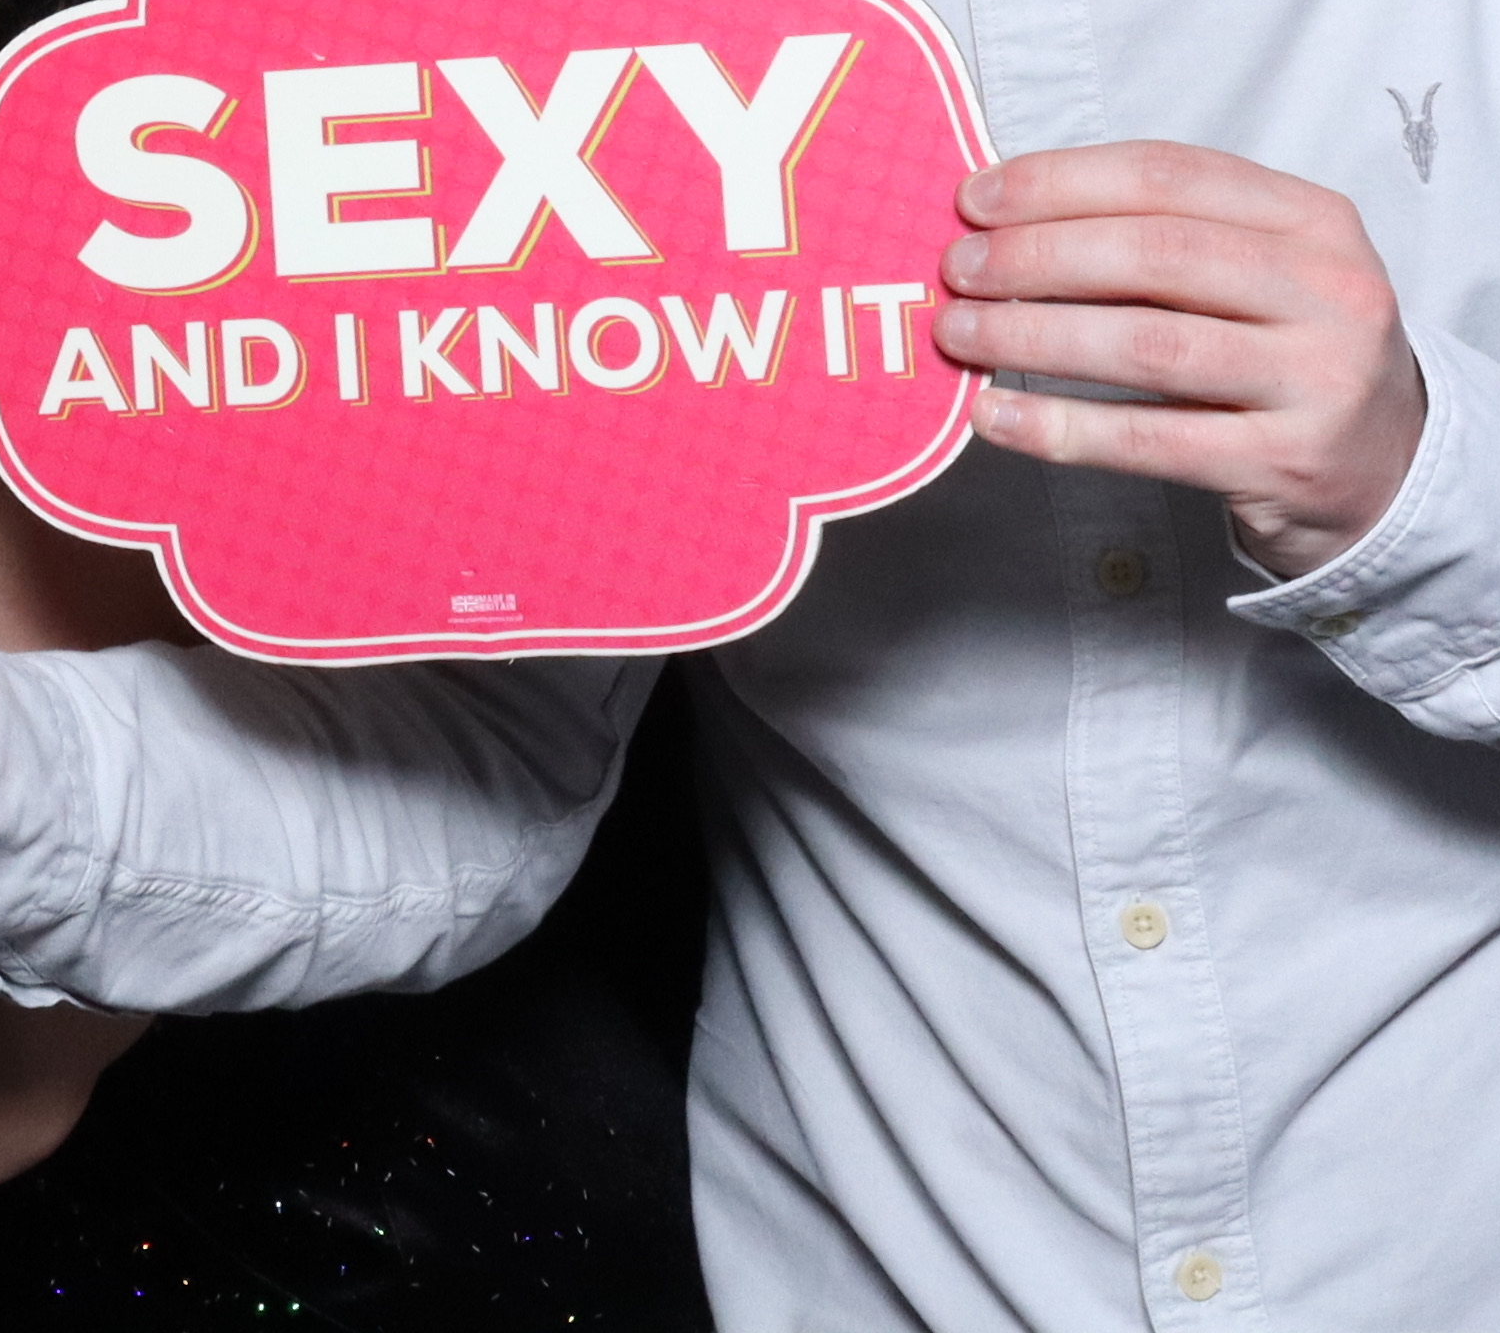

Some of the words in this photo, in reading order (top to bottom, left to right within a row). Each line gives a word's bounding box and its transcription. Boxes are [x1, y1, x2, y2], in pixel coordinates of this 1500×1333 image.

[74, 31, 862, 294] SEXY
[37, 311, 305, 418] AND
[334, 311, 366, 405] I
[400, 289, 794, 399] KNOW
[821, 281, 932, 379] IT
